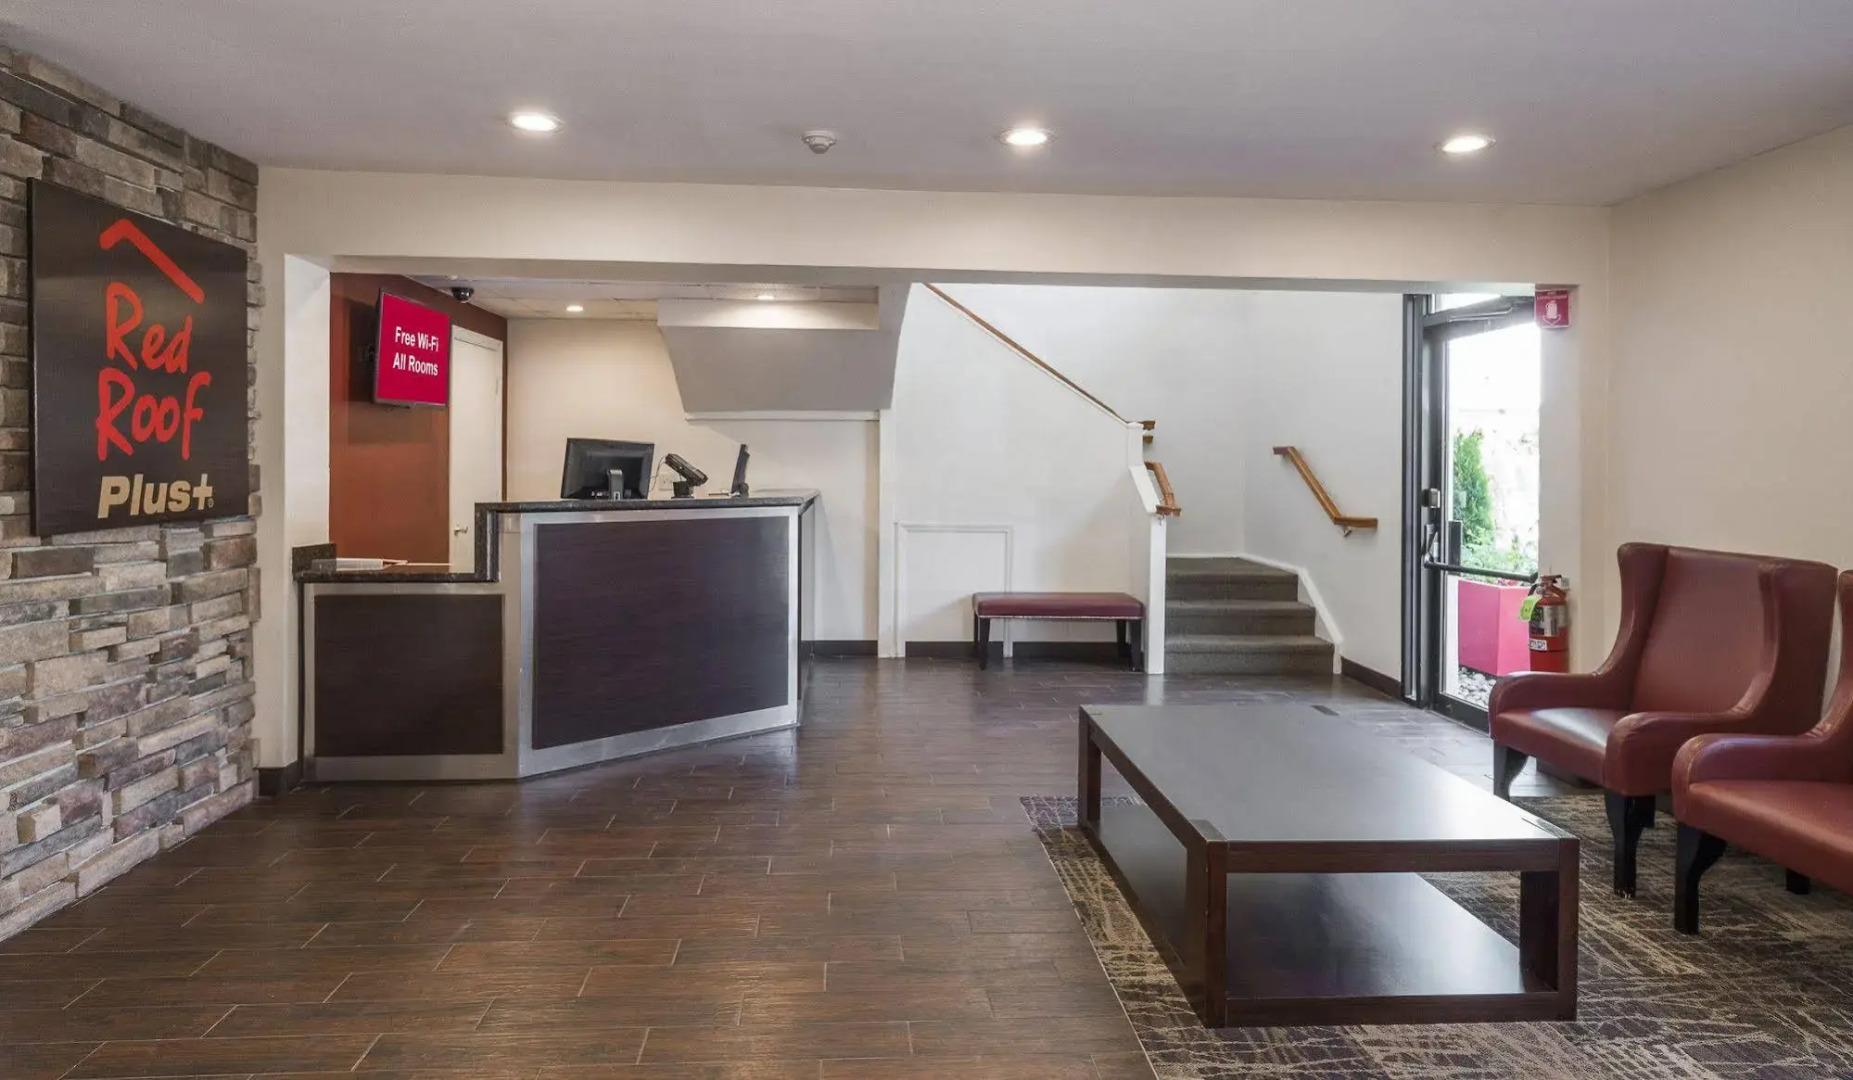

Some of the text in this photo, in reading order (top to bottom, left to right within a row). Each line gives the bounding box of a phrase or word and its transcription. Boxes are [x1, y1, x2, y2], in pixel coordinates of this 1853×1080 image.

[106, 282, 192, 374] Red
[395, 326, 439, 352] Free Wi-Fi
[392, 352, 438, 376] All Rooms
[95, 367, 212, 461] Roof
